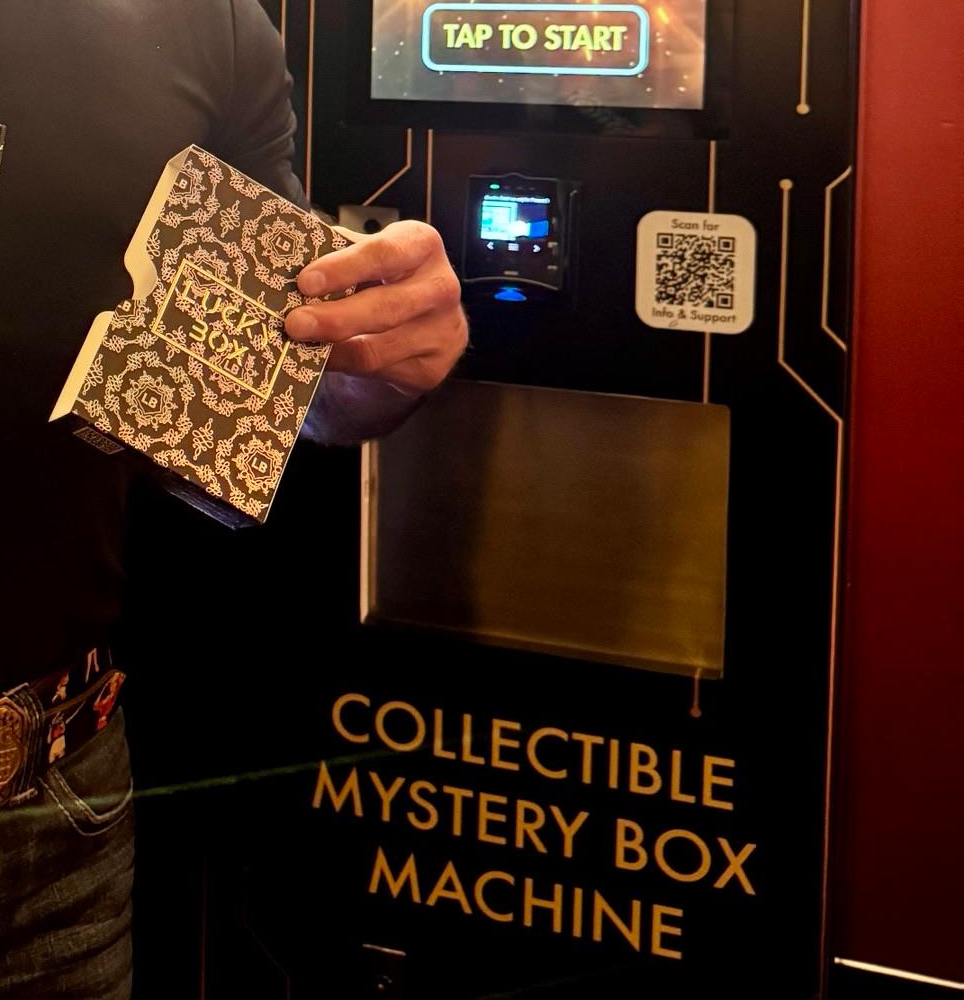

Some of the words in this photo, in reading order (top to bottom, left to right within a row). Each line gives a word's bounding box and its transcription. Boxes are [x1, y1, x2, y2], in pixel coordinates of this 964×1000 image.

[442, 22, 493, 50] TAP
[498, 23, 538, 50] TO
[543, 24, 628, 51] START
[671, 218, 699, 230] Scan
[703, 219, 720, 231] for
[652, 307, 674, 318] Info
[677, 309, 686, 319] &
[690, 310, 737, 324] Support
[332, 693, 735, 811] COLLECTIBLE
[312, 760, 589, 858] MYSTERY
[615, 818, 757, 896] BOX
[369, 846, 684, 960] MACHINE
